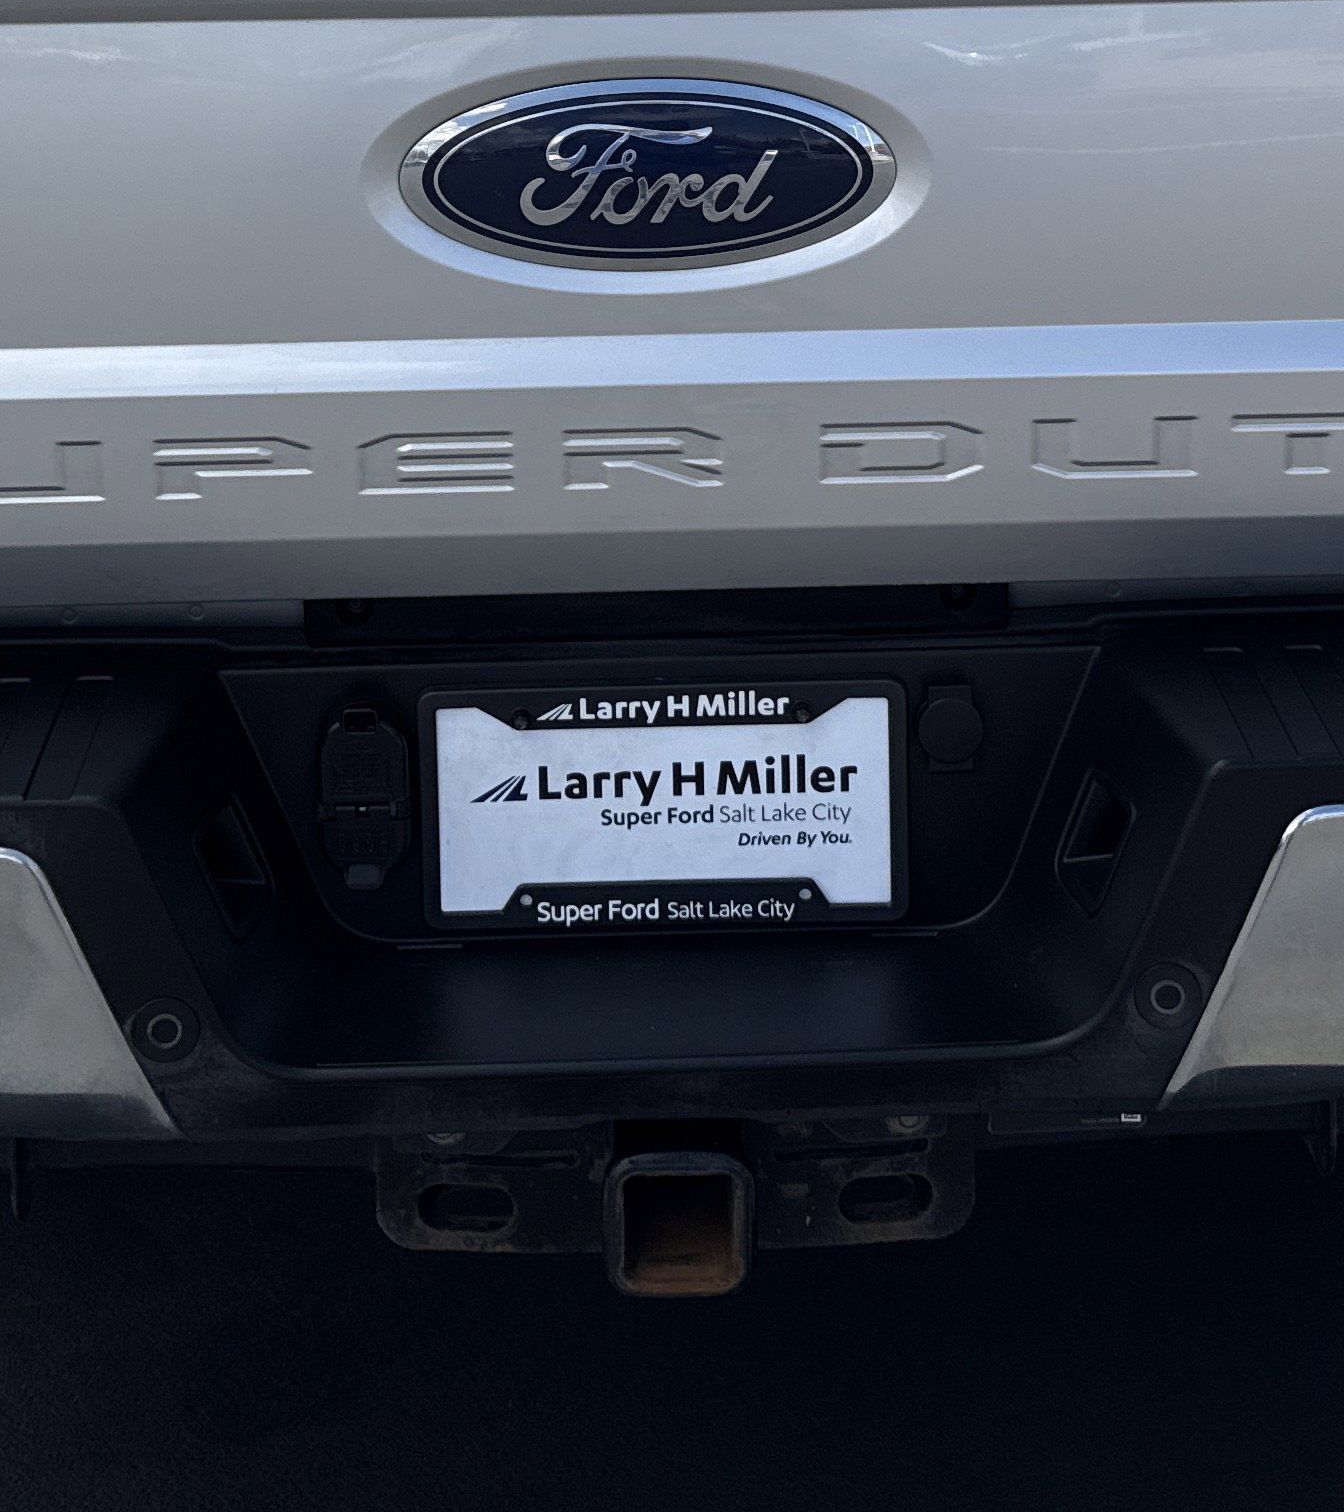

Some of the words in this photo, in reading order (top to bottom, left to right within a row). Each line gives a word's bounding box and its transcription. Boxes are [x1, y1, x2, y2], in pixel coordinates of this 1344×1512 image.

[518, 122, 780, 227] Ford
[579, 696, 661, 724] Larry
[666, 695, 690, 718] H
[697, 690, 790, 717] Miller
[538, 764, 662, 806] Larry
[672, 761, 705, 796] H
[716, 753, 858, 795] Miller
[600, 808, 662, 830] Super
[667, 804, 714, 824] Ford
[719, 803, 756, 824] Salt
[761, 802, 807, 822] Lake
[811, 802, 852, 824] City
[738, 831, 792, 847] Driven
[796, 831, 818, 848] By
[537, 901, 603, 927] Super
[608, 898, 660, 920] Ford
[667, 900, 704, 919] Salt
[708, 899, 753, 918] Lake
[757, 898, 795, 921] City
